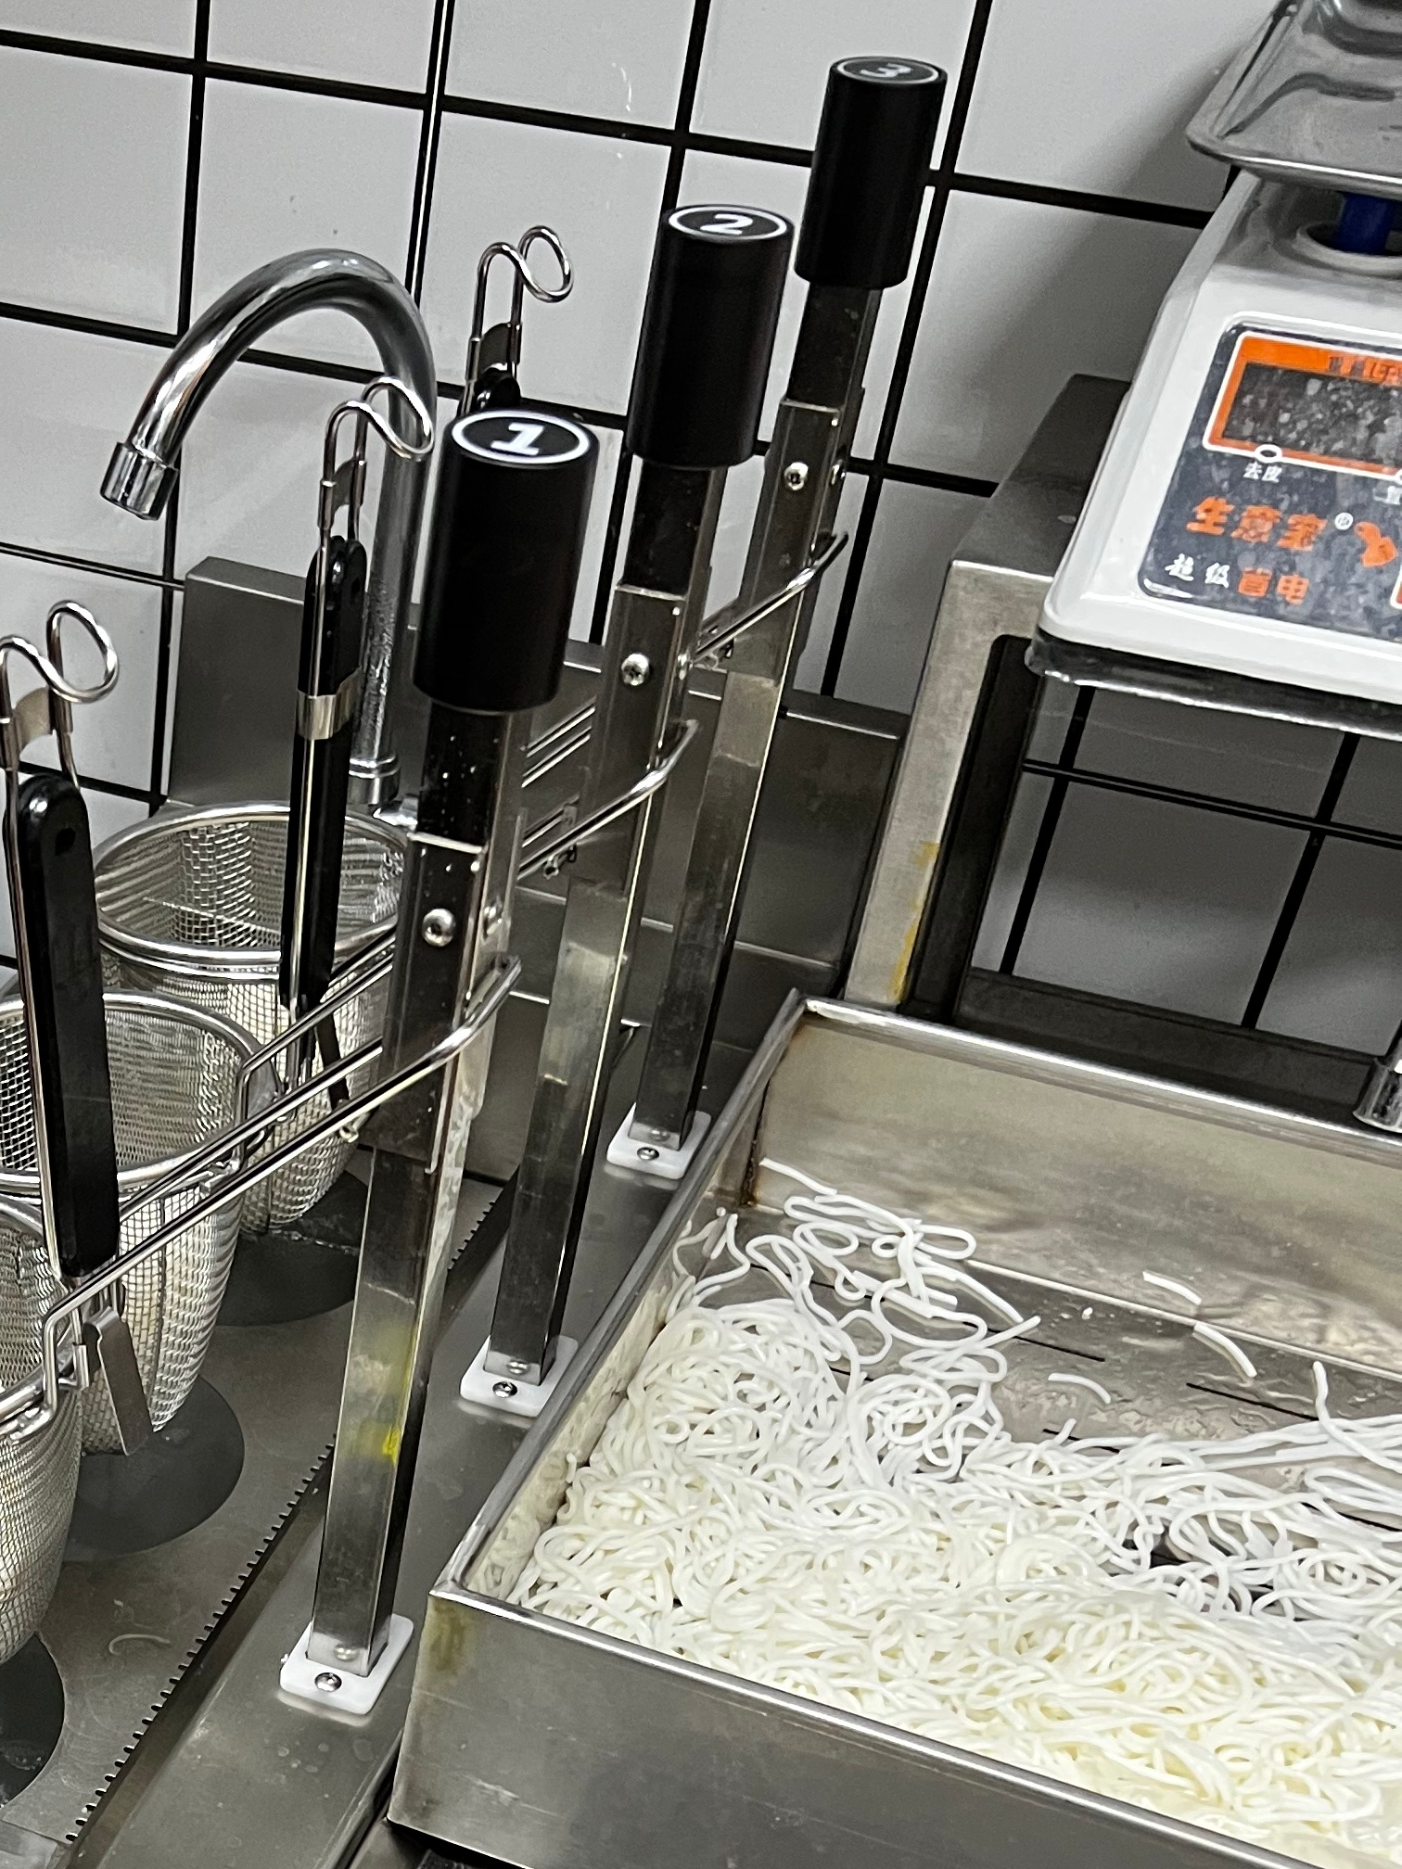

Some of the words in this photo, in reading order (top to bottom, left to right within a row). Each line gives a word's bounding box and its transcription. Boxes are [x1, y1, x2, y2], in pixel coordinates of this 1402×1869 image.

[859, 62, 911, 78] 3
[698, 213, 754, 234] 2
[490, 421, 546, 456] 1
